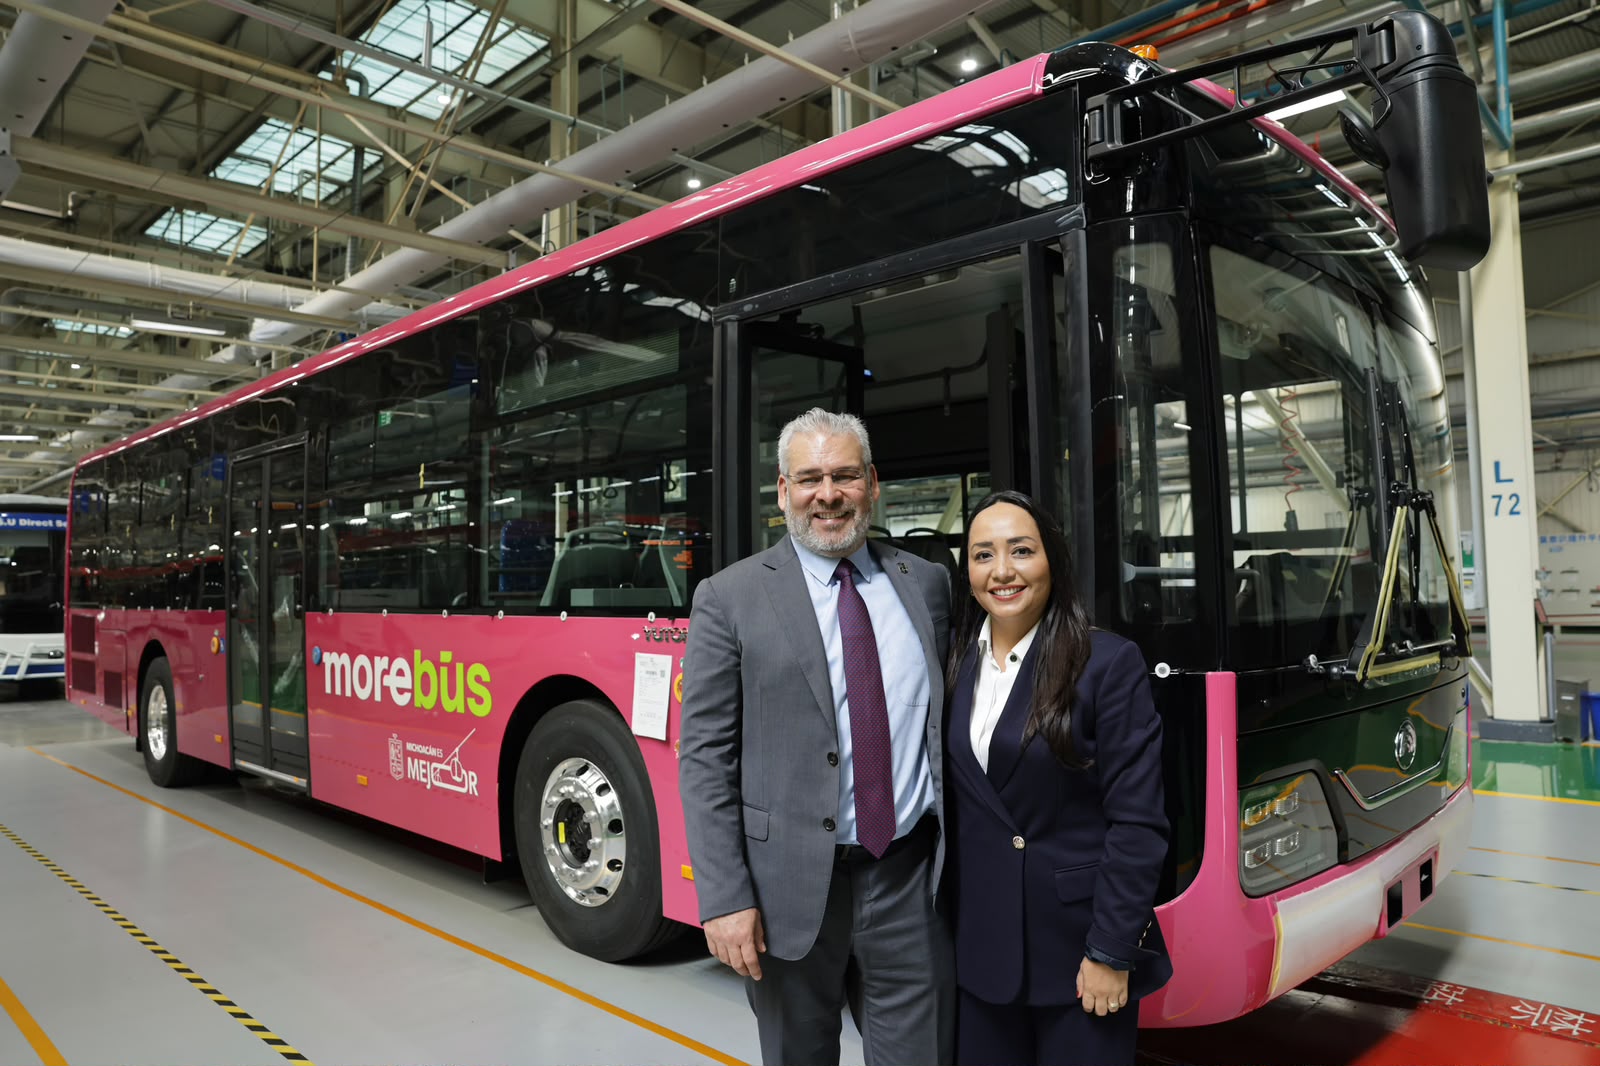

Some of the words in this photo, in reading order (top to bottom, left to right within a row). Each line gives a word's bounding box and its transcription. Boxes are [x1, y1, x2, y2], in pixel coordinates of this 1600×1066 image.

[1493, 460, 1514, 483] L
[1490, 492, 1521, 516] 72
[18, 518, 54, 528] Direct
